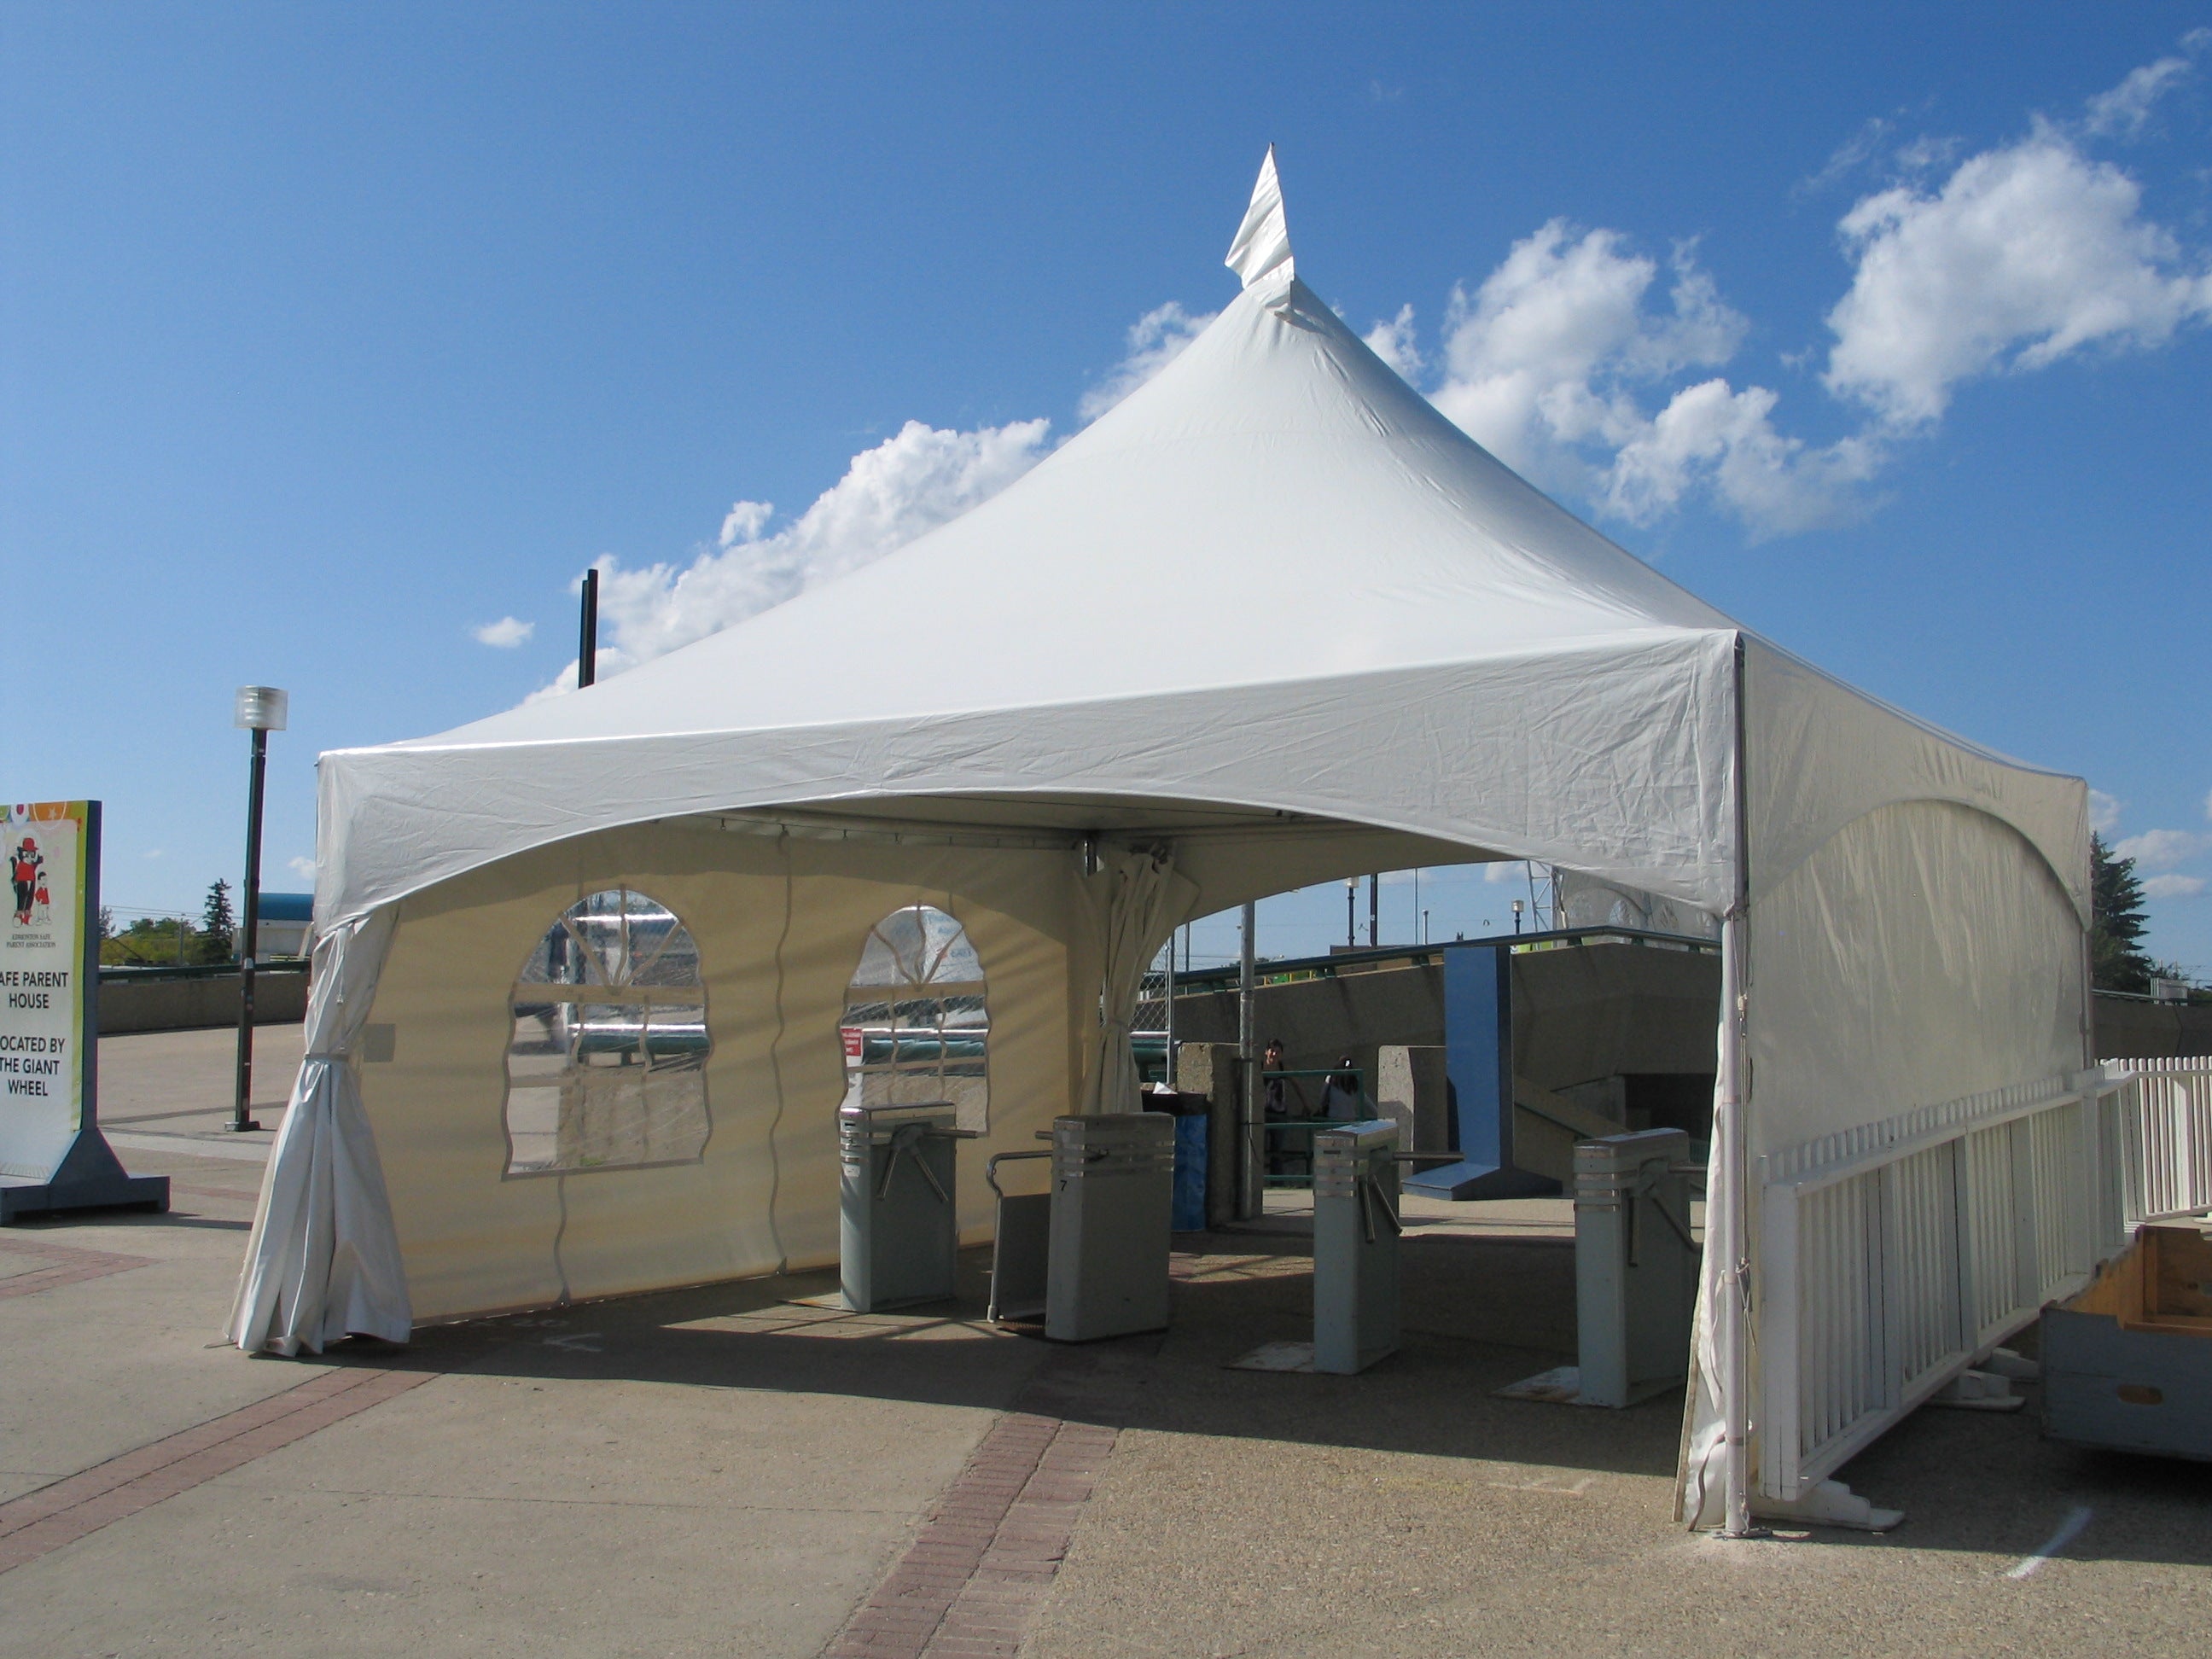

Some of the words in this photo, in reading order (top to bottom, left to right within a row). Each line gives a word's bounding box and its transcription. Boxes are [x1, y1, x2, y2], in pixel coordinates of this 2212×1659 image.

[23, 971, 68, 987] PARENT
[9, 992, 49, 1009] HOUSE
[0, 1035, 46, 1052] OCATED
[50, 1038, 66, 1053] BY
[0, 1057, 19, 1073] THE
[23, 1058, 60, 1074] GIANT
[8, 1079, 48, 1097] WHEEL
[1060, 1179, 1067, 1191] 7
